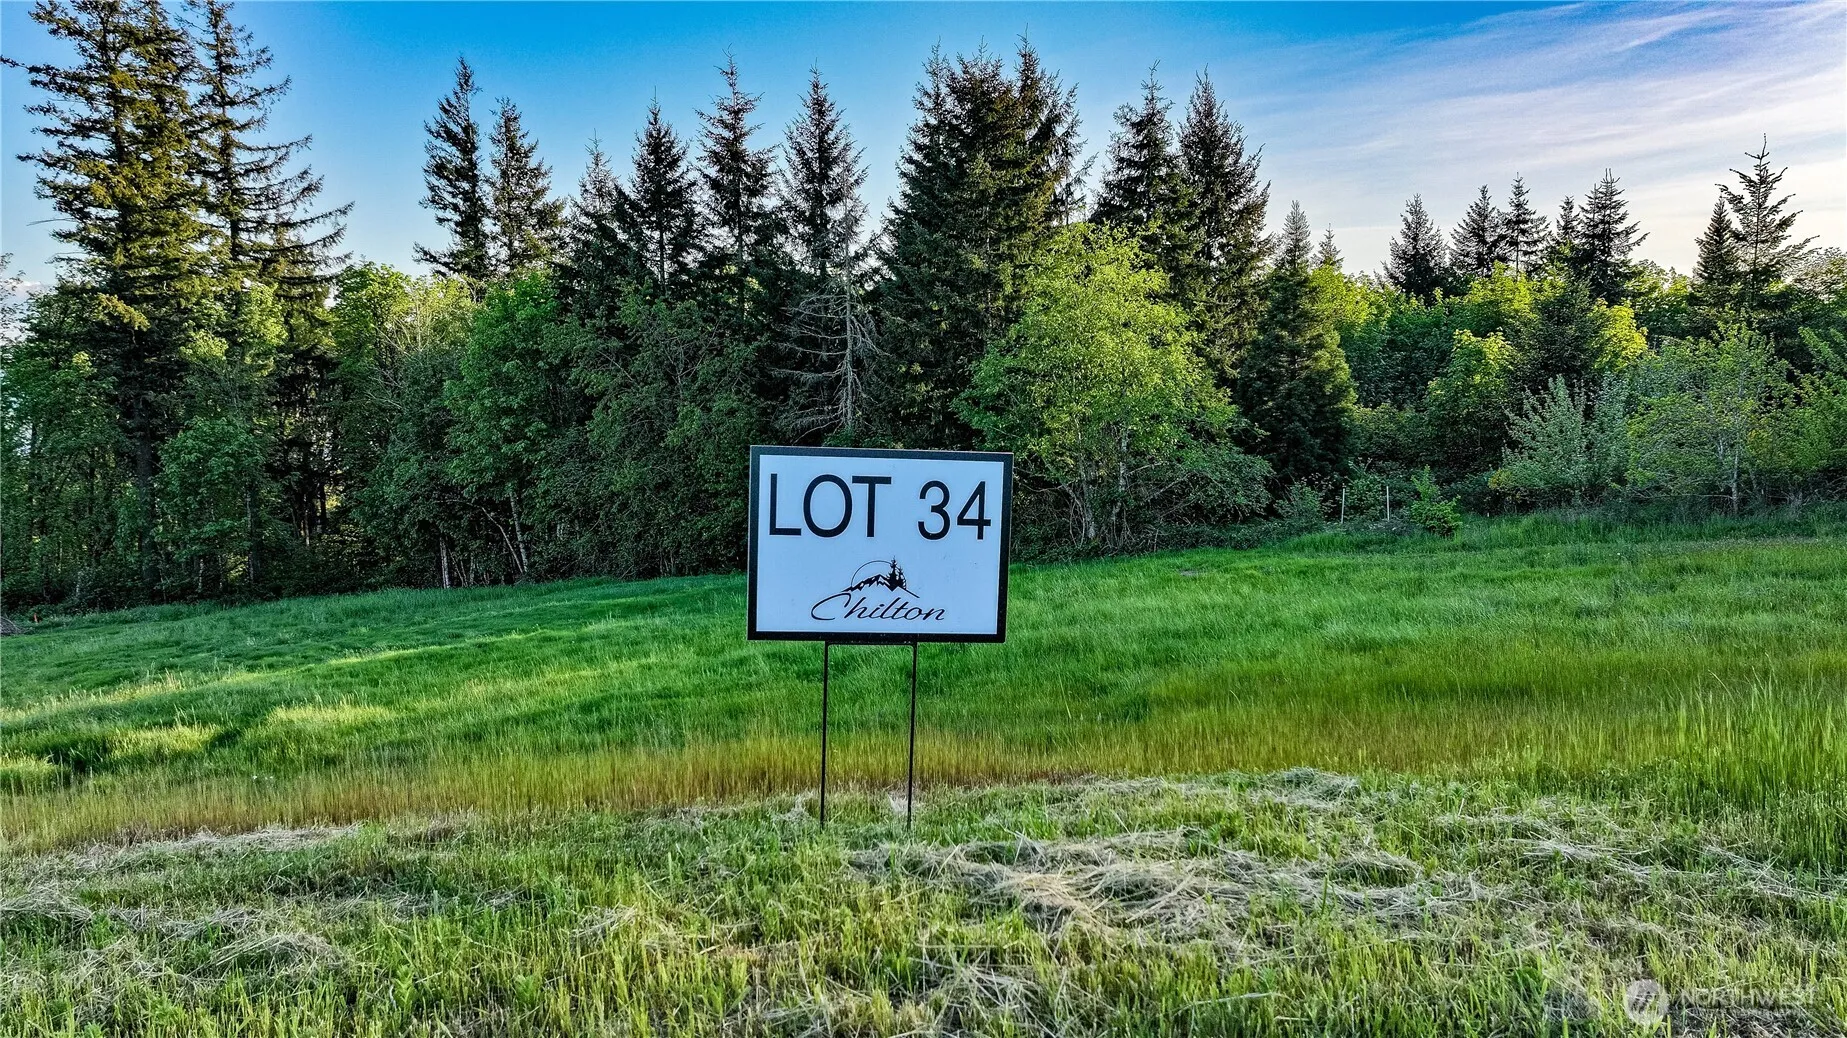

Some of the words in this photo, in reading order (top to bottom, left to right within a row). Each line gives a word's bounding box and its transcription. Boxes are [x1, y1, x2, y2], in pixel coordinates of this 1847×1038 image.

[769, 473, 892, 538] LOT
[917, 480, 992, 541] 34
[810, 592, 946, 621] Chilton
